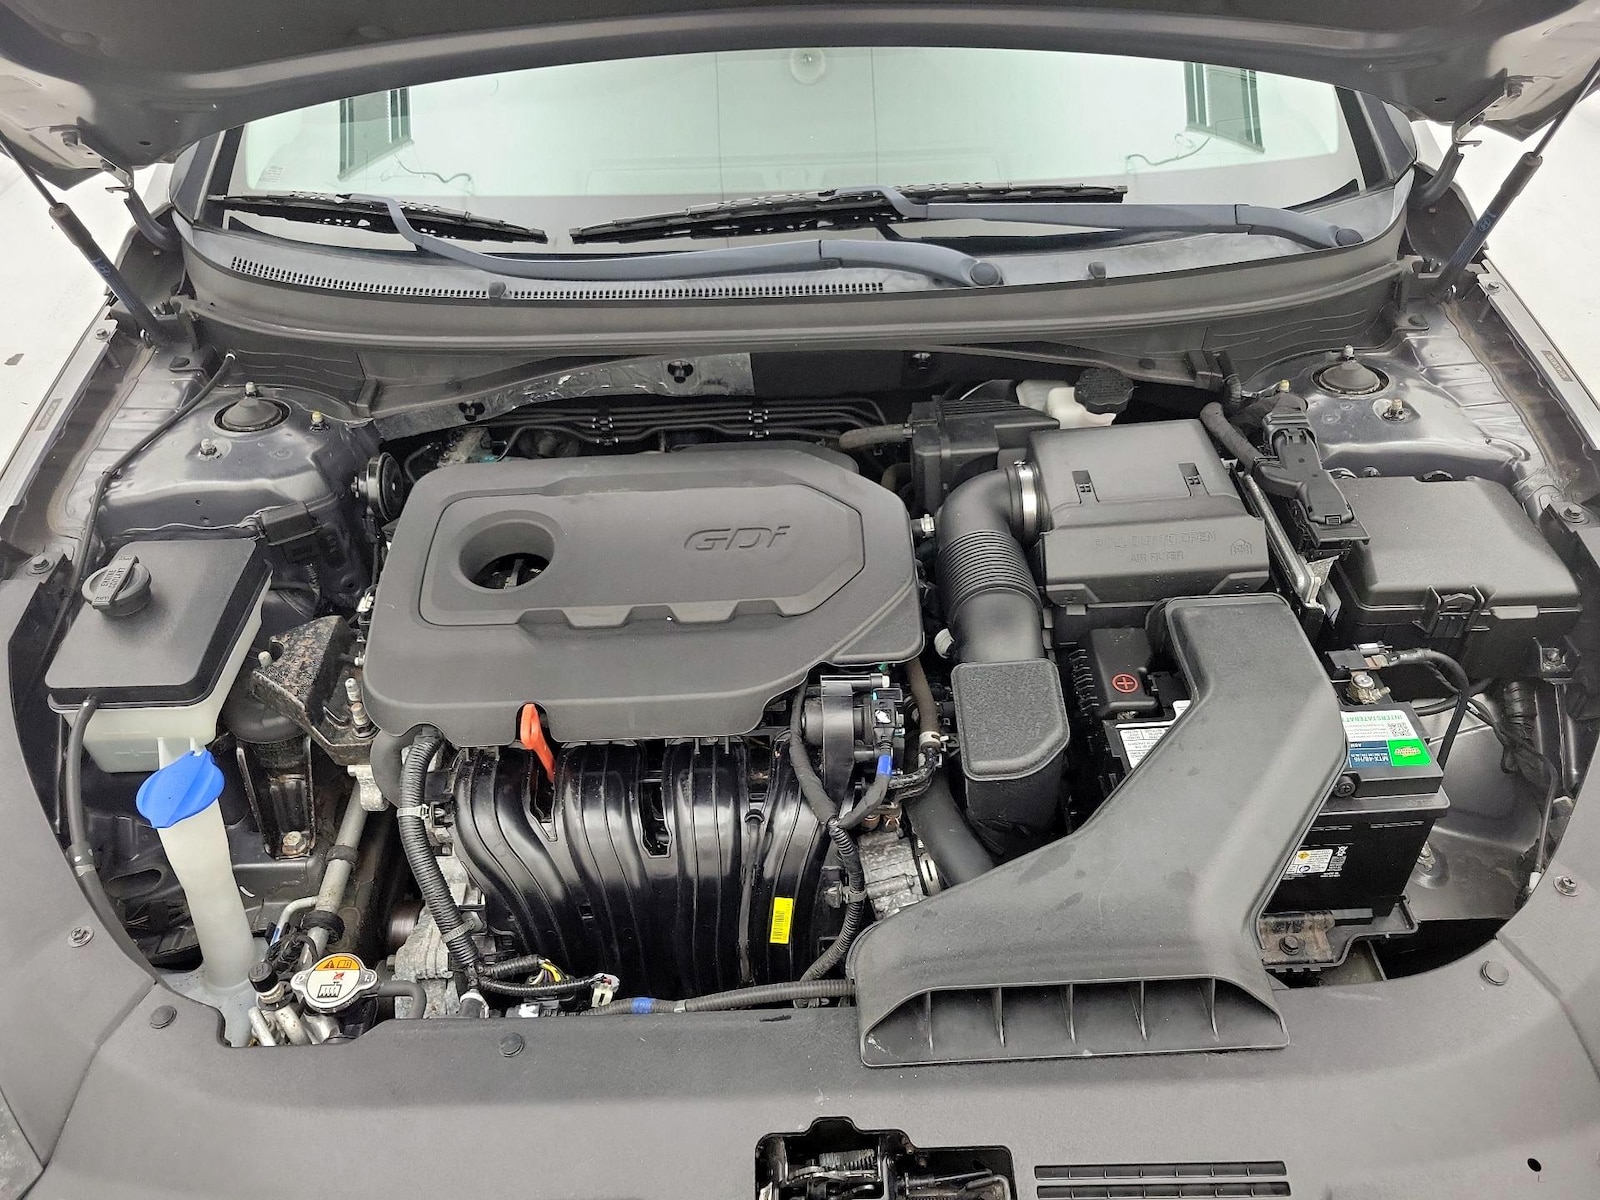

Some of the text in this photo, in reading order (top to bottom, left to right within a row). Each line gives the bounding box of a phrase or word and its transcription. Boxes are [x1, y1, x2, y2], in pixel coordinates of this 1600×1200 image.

[1181, 530, 1217, 543] OPEN
[1129, 551, 1185, 563] AIR FILTER
[1343, 714, 1402, 722] INTERSTATEBAT
